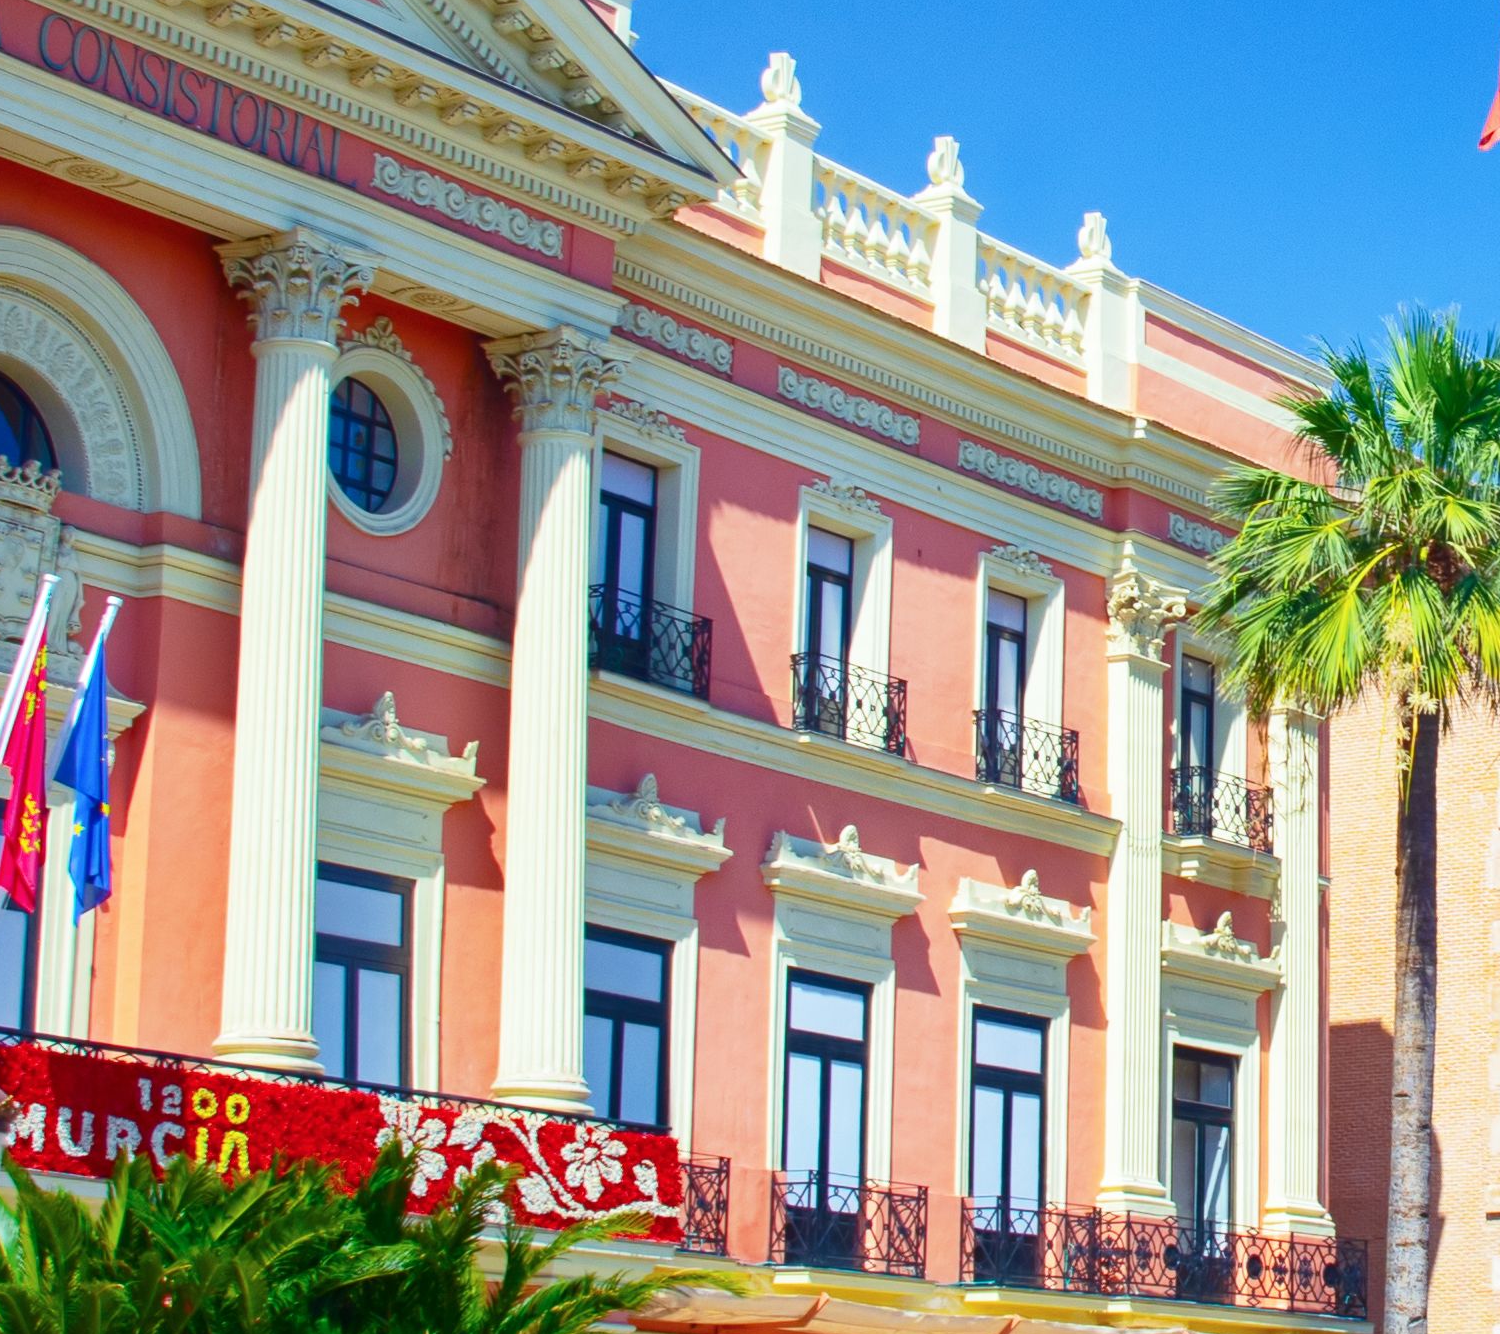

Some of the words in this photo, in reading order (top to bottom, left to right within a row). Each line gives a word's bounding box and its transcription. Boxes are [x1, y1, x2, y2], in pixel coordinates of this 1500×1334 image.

[39, 13, 358, 189] CONSISTORIAL
[138, 1077, 251, 1124] 1200
[5, 1101, 251, 1177] MURCIA
